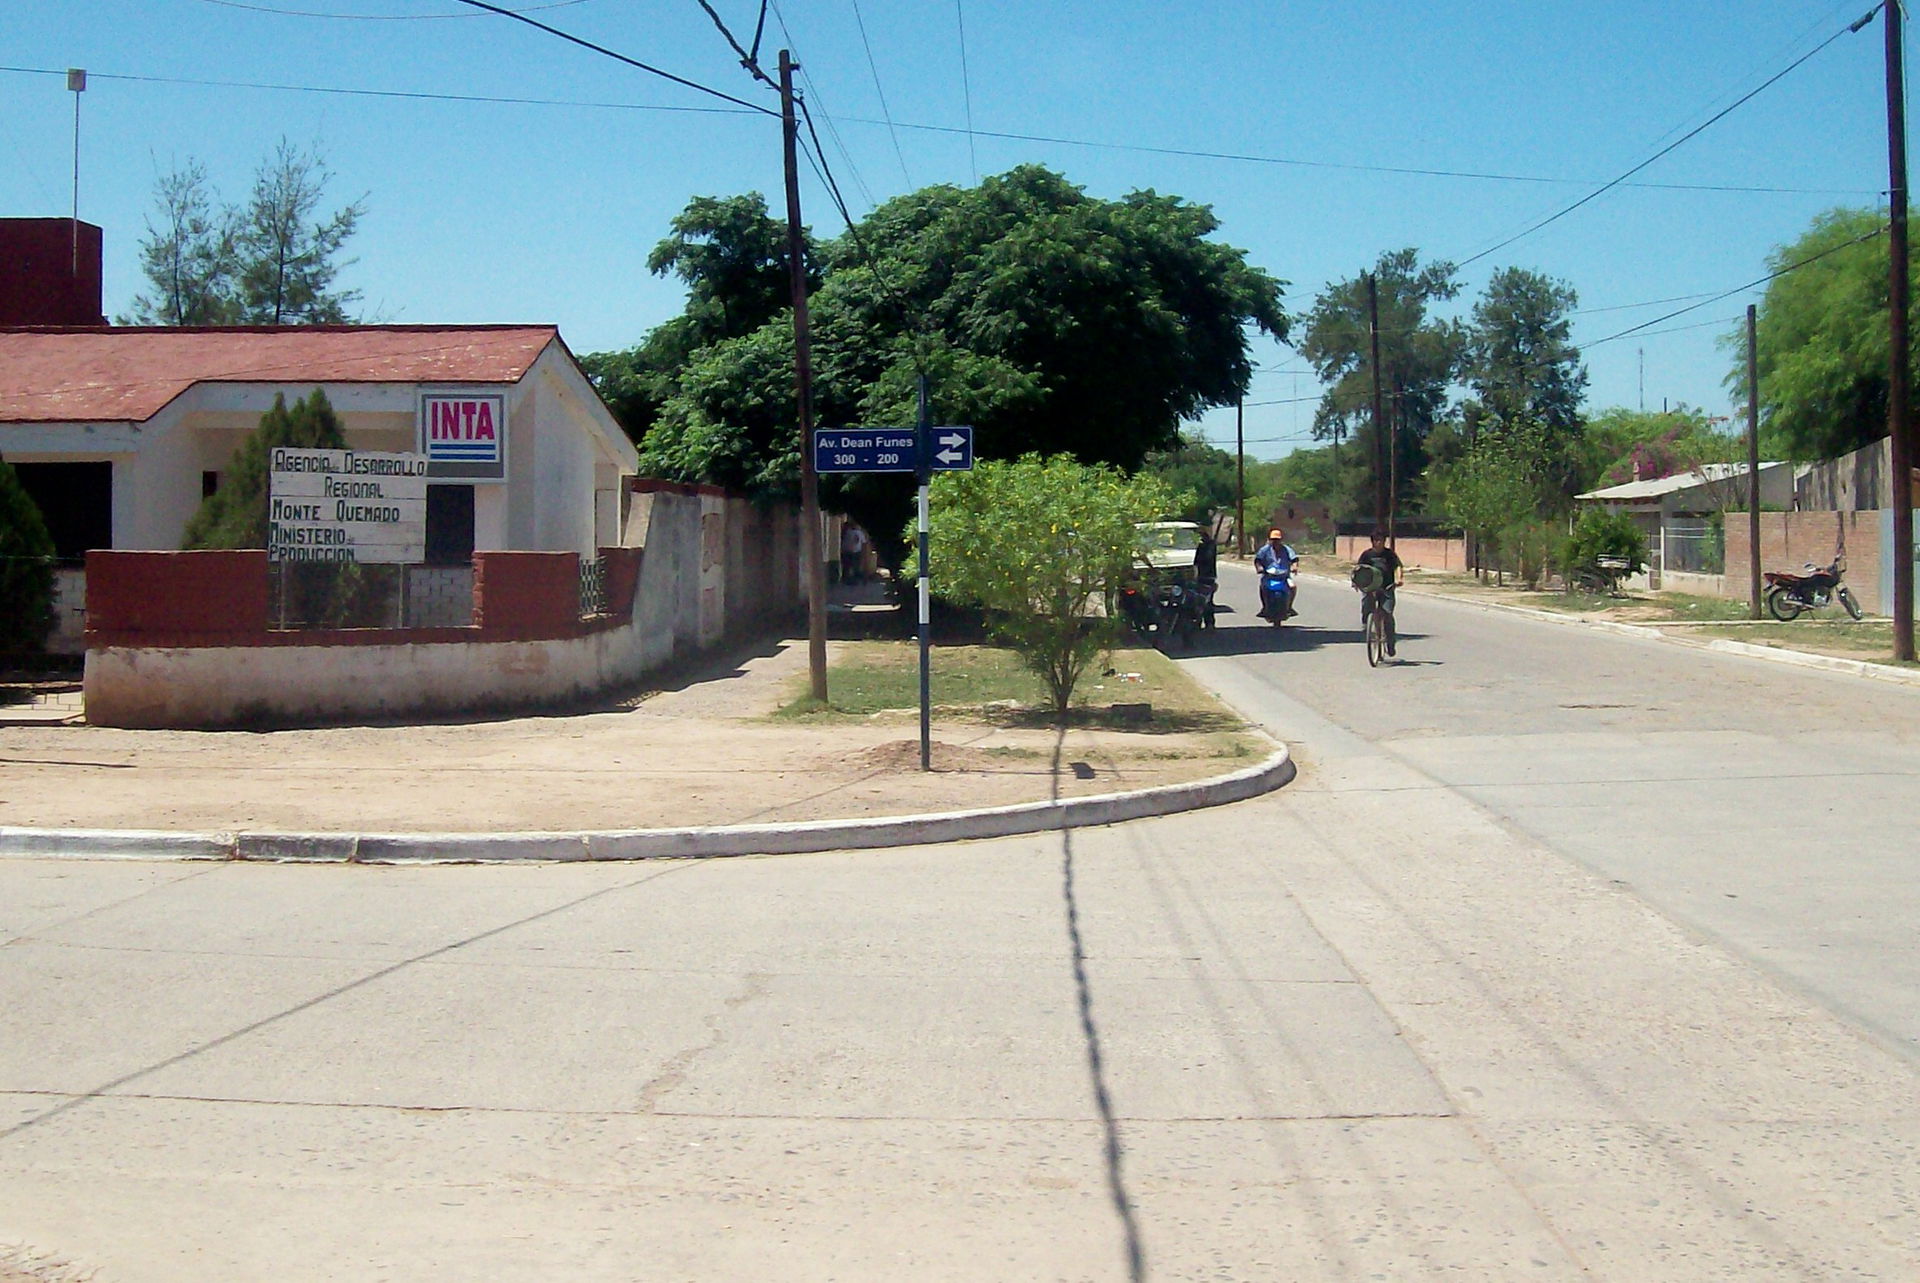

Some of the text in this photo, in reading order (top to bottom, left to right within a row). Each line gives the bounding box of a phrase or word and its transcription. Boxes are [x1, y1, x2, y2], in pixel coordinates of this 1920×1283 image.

[431, 401, 495, 440] INTA
[819, 437, 914, 448] Av. Dean Funes
[344, 452, 425, 476] DESARROLLO
[833, 454, 856, 465] 300
[876, 454, 899, 464] 200
[324, 477, 384, 498] REGIONAL
[272, 500, 400, 522] MONTE QUEMADO
[270, 522, 346, 544] MINISTERIO
